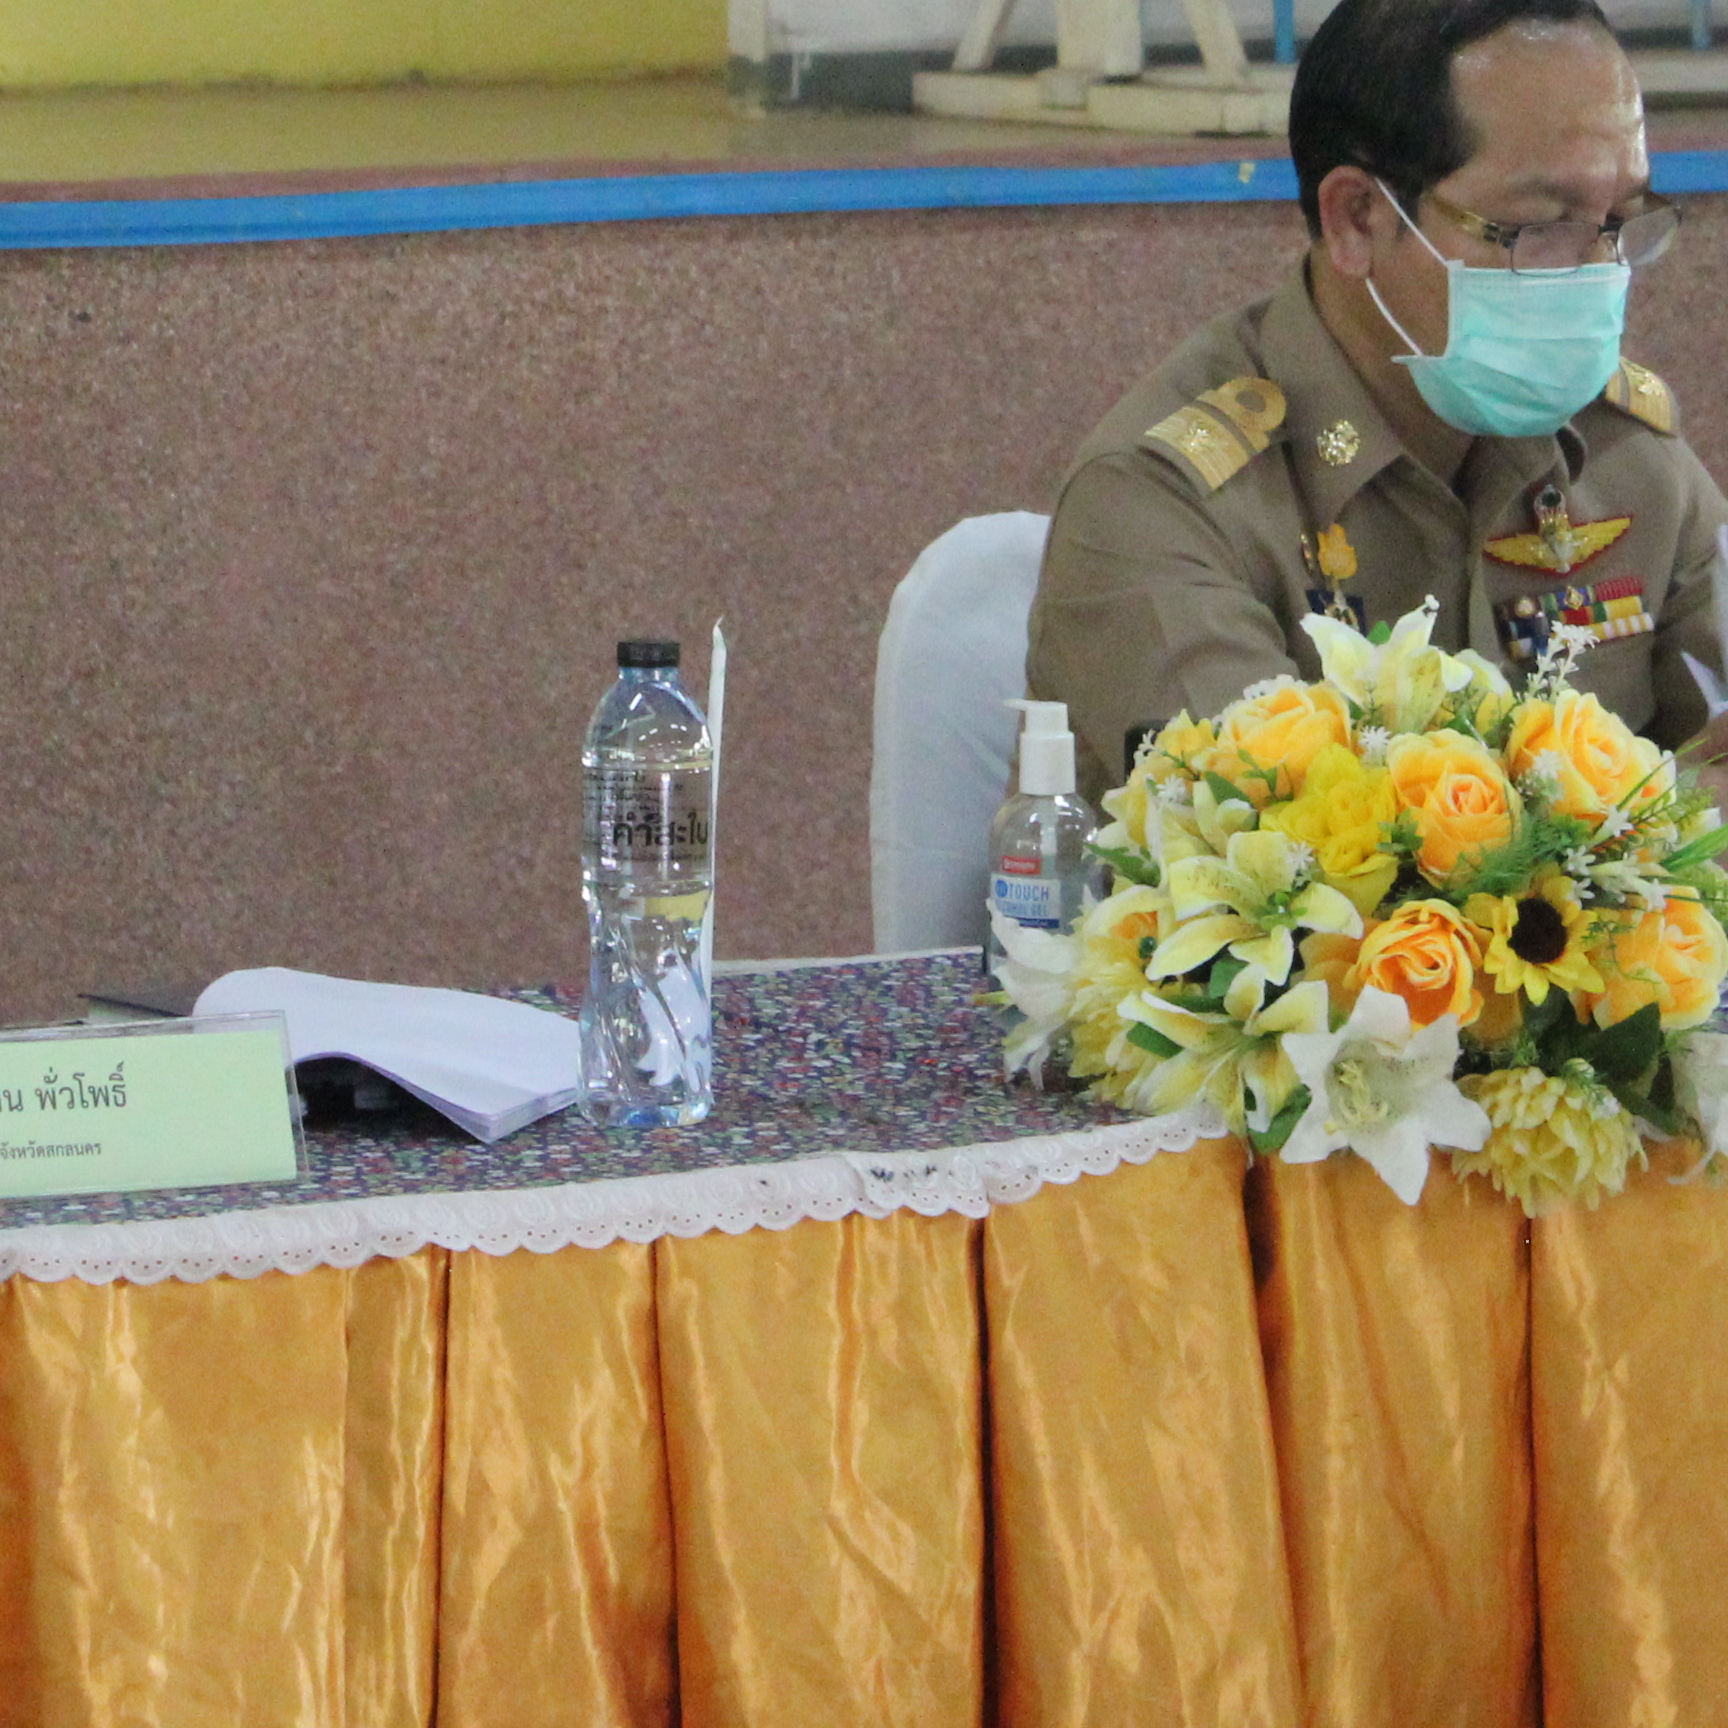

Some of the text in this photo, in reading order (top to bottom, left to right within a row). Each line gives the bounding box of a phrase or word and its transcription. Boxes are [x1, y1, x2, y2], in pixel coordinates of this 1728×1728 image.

[1009, 883, 1050, 902] TOUCH
[34, 1060, 127, 1112] พั่วโพธิ์
